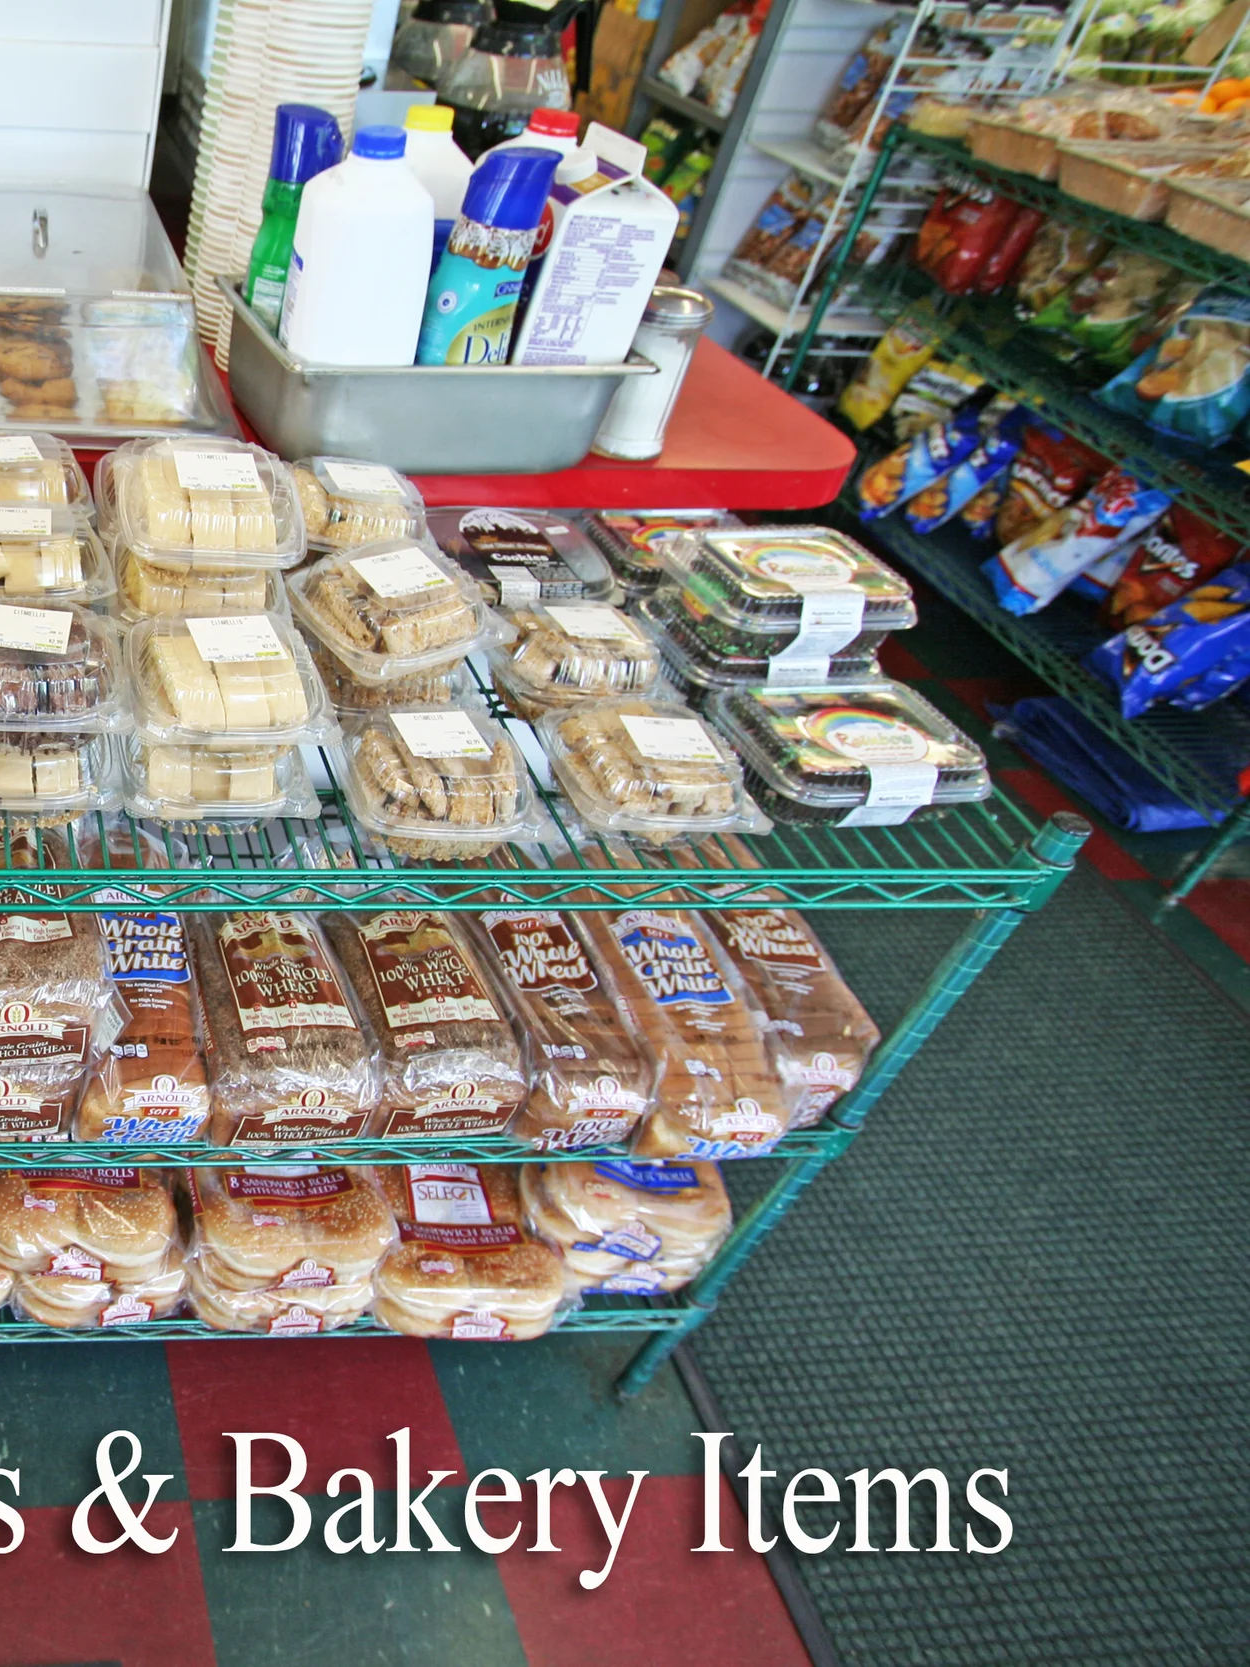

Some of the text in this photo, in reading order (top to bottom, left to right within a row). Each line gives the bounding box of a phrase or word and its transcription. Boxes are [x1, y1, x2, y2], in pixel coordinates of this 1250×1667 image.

[491, 552, 549, 562] Cookies
[13, 609, 46, 618] CITARELLIS
[101, 919, 183, 938] Whole
[513, 920, 541, 930] SOFT
[726, 921, 807, 942] Whole
[107, 936, 184, 955] Grain
[513, 932, 554, 946] 100%
[729, 934, 819, 957] Wheat
[499, 941, 581, 968] Whole
[622, 939, 707, 964] Whole
[110, 952, 185, 974] White
[634, 957, 716, 980] Grain
[234, 964, 333, 987] 100% WHOLE
[379, 961, 419, 983] 100%
[503, 956, 589, 985] Wheat
[256, 978, 318, 997] WHEAT
[404, 970, 465, 992] WHEAT
[643, 973, 721, 999] White
[32, 1044, 75, 1055] WHEAT
[137, 1094, 190, 1104] ARNOLD
[433, 1098, 489, 1111] ARNOLD
[147, 1107, 177, 1116] SOFT
[279, 1106, 339, 1117] ARNOLD
[11, 1119, 52, 1129] WHEAT
[396, 1118, 502, 1133] 100% WHOLE WHEAT
[424, 1115, 482, 1126] Whole Grains
[573, 1119, 628, 1132] 100%
[246, 1129, 353, 1139] 100% WHOLE WHEAT
[273, 1124, 301, 1132] Whole
[97, 1168, 135, 1178] ROLLS
[418, 1164, 467, 1174] ARNOLD
[54, 1171, 125, 1186] SESAME SEEDS
[230, 1173, 345, 1190] 8 SANDWICH ROLLS
[242, 1184, 338, 1197] WITH SESAME SEEDS
[417, 1184, 479, 1202] SELECT
[413, 1225, 517, 1238] SANDWICH ROLLS
[441, 1236, 479, 1245] SESAME
[111, 1304, 144, 1315] ARNOLD
